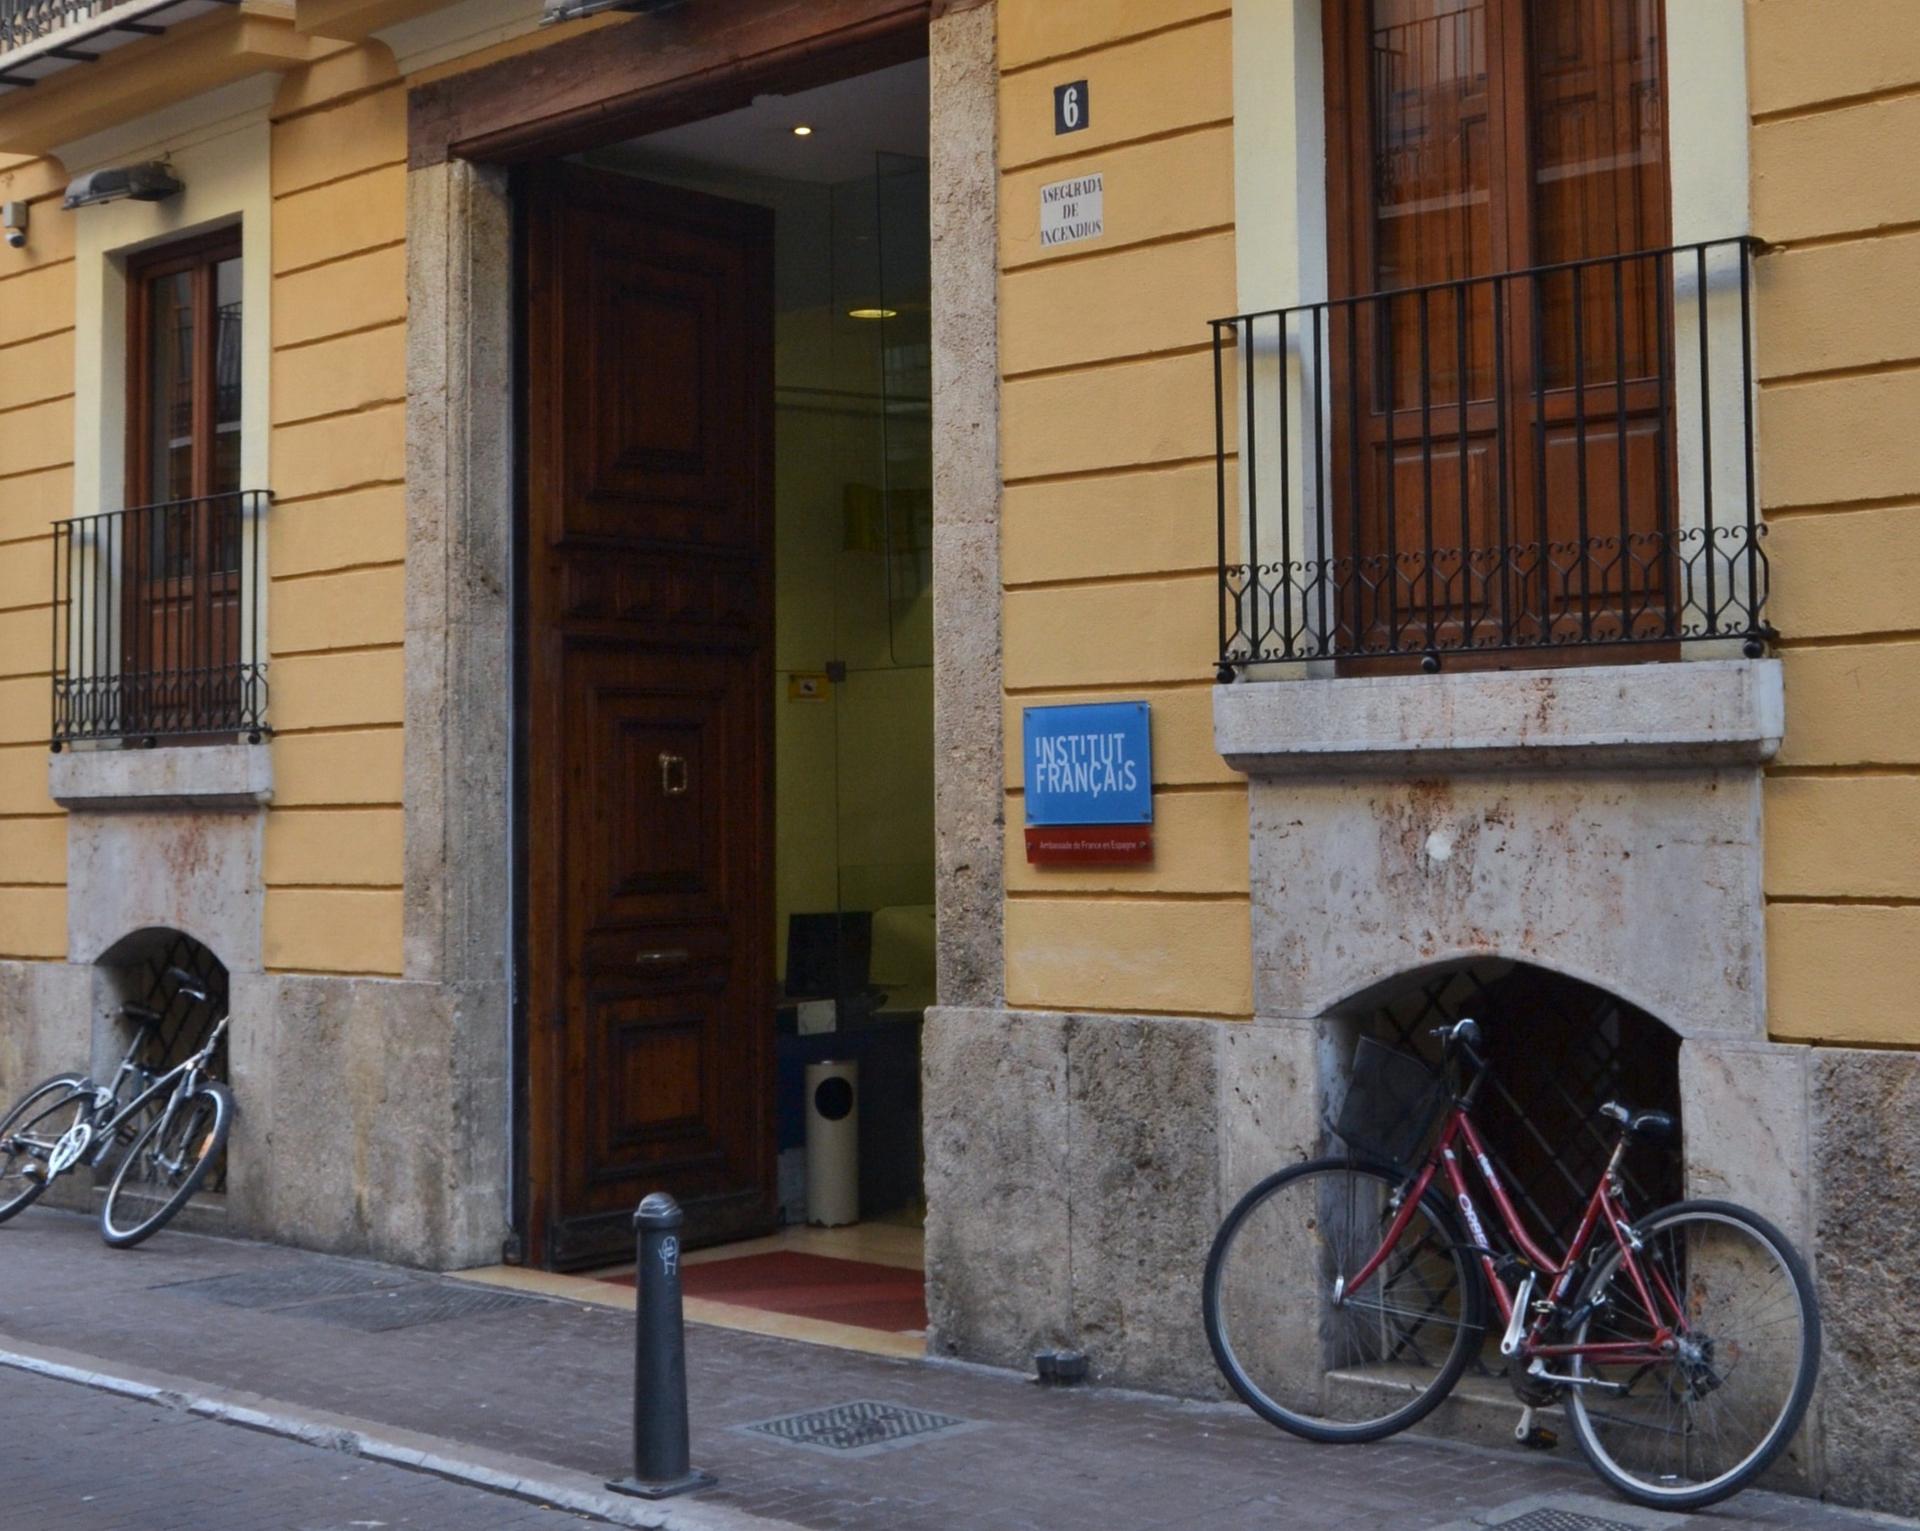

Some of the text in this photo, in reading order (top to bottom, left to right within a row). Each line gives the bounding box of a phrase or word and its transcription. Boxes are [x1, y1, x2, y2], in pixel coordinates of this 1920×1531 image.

[1063, 87, 1079, 128] 6
[1043, 177, 1103, 204] ASEGURADA
[1063, 202, 1079, 219] DE
[1041, 220, 1102, 245] INCENDIOS
[1035, 733, 1125, 767] INSTITUT
[1036, 760, 1137, 798] FRANÇAIS
[1081, 840, 1102, 849] France
